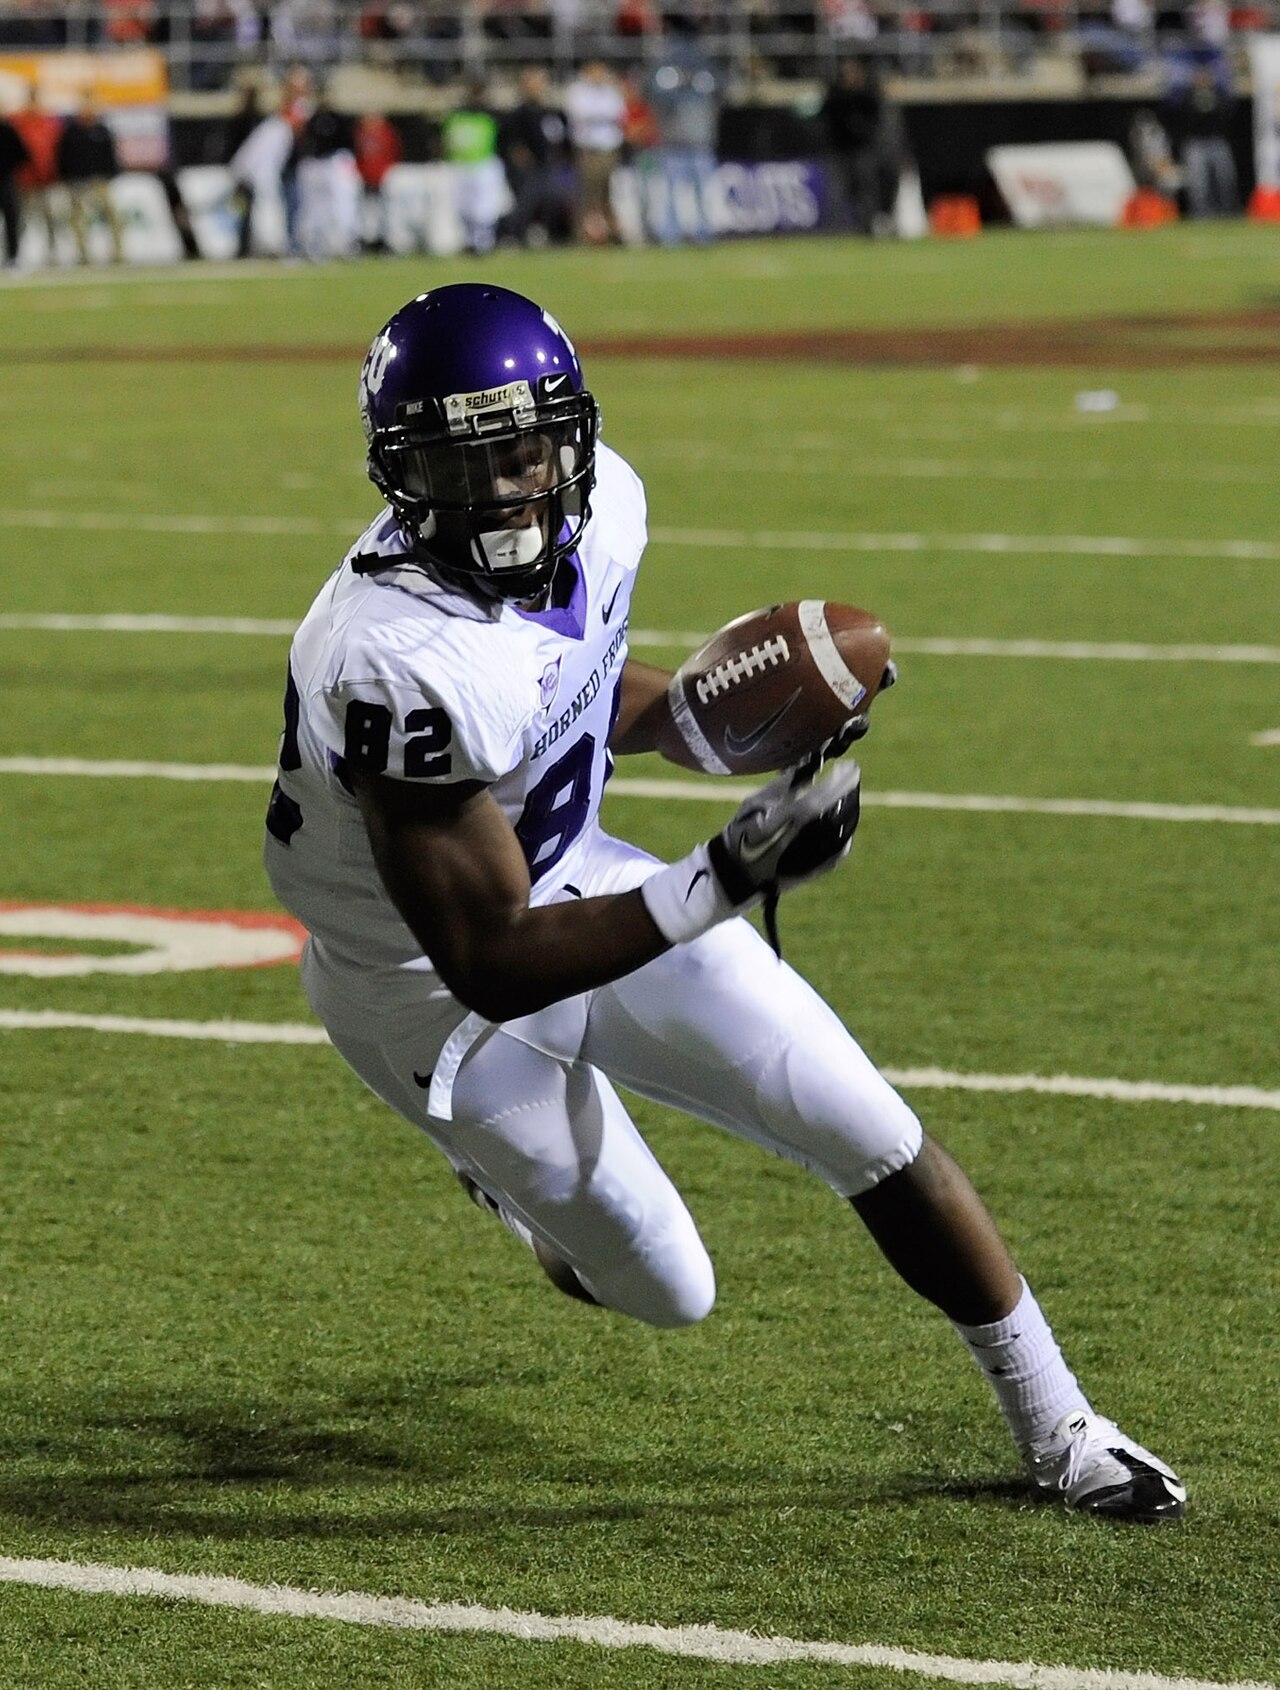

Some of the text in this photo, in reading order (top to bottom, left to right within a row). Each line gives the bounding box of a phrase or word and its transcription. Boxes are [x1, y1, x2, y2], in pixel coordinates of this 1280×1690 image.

[465, 387, 508, 409] schutt
[344, 699, 453, 778] 82
[530, 668, 601, 762] HORNED
